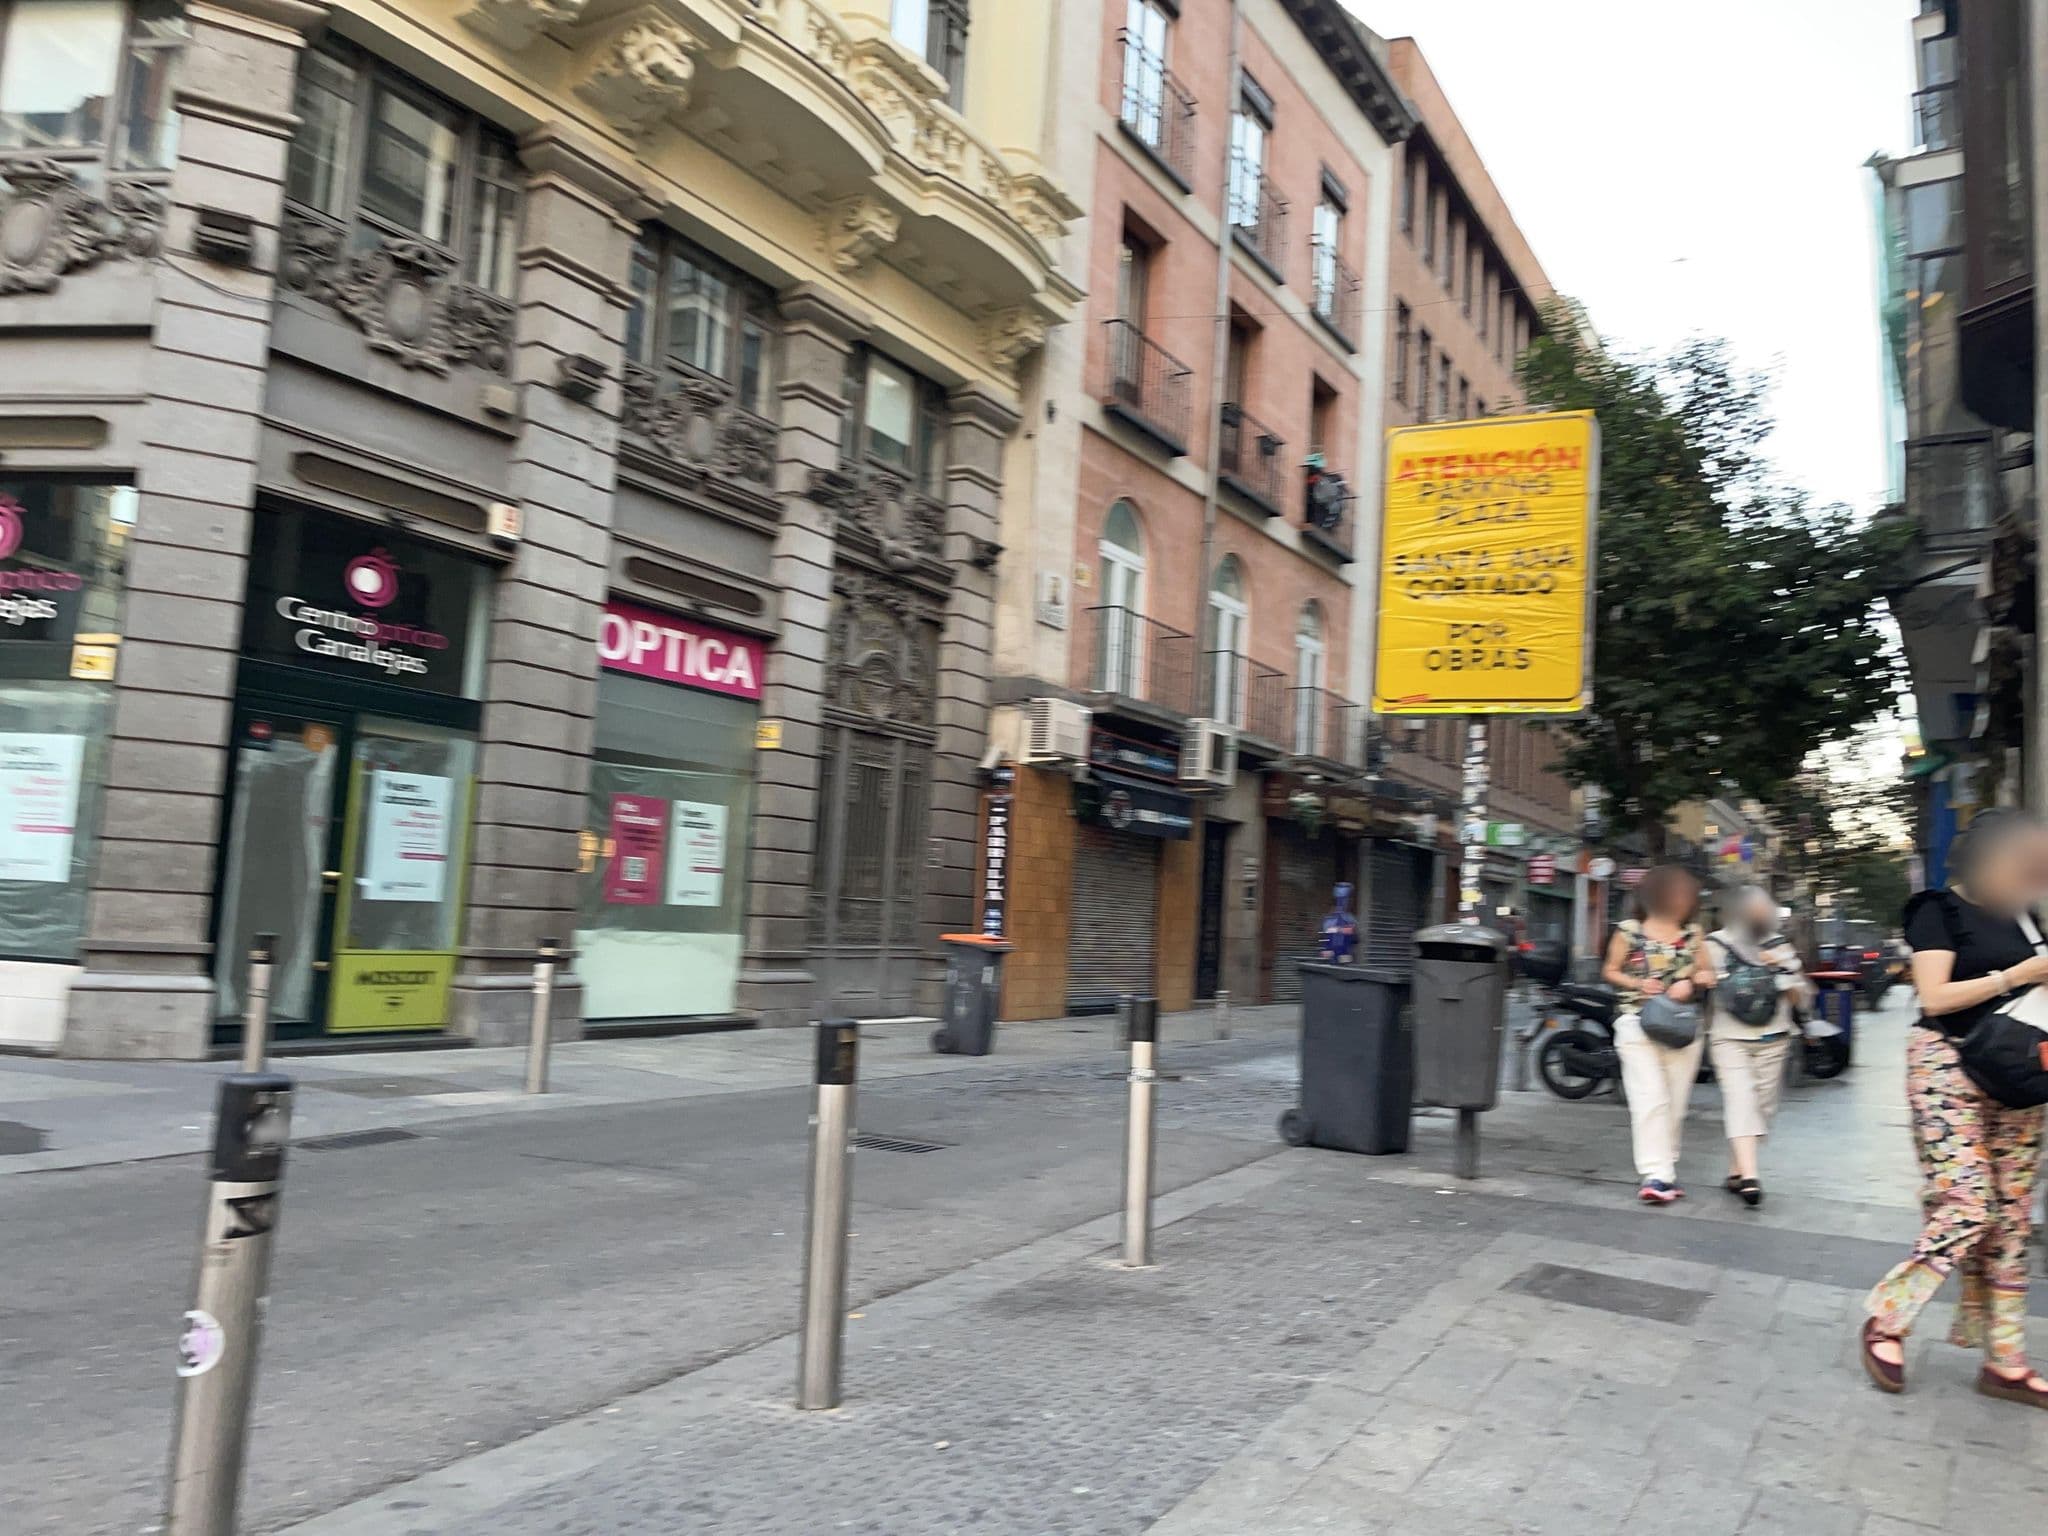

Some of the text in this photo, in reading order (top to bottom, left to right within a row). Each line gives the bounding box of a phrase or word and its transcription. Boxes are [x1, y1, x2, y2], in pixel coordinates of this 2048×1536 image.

[1396, 446, 1582, 479] ATENCIÓN
[1448, 621, 1507, 646] POR
[1424, 647, 1532, 672] OBRAS
